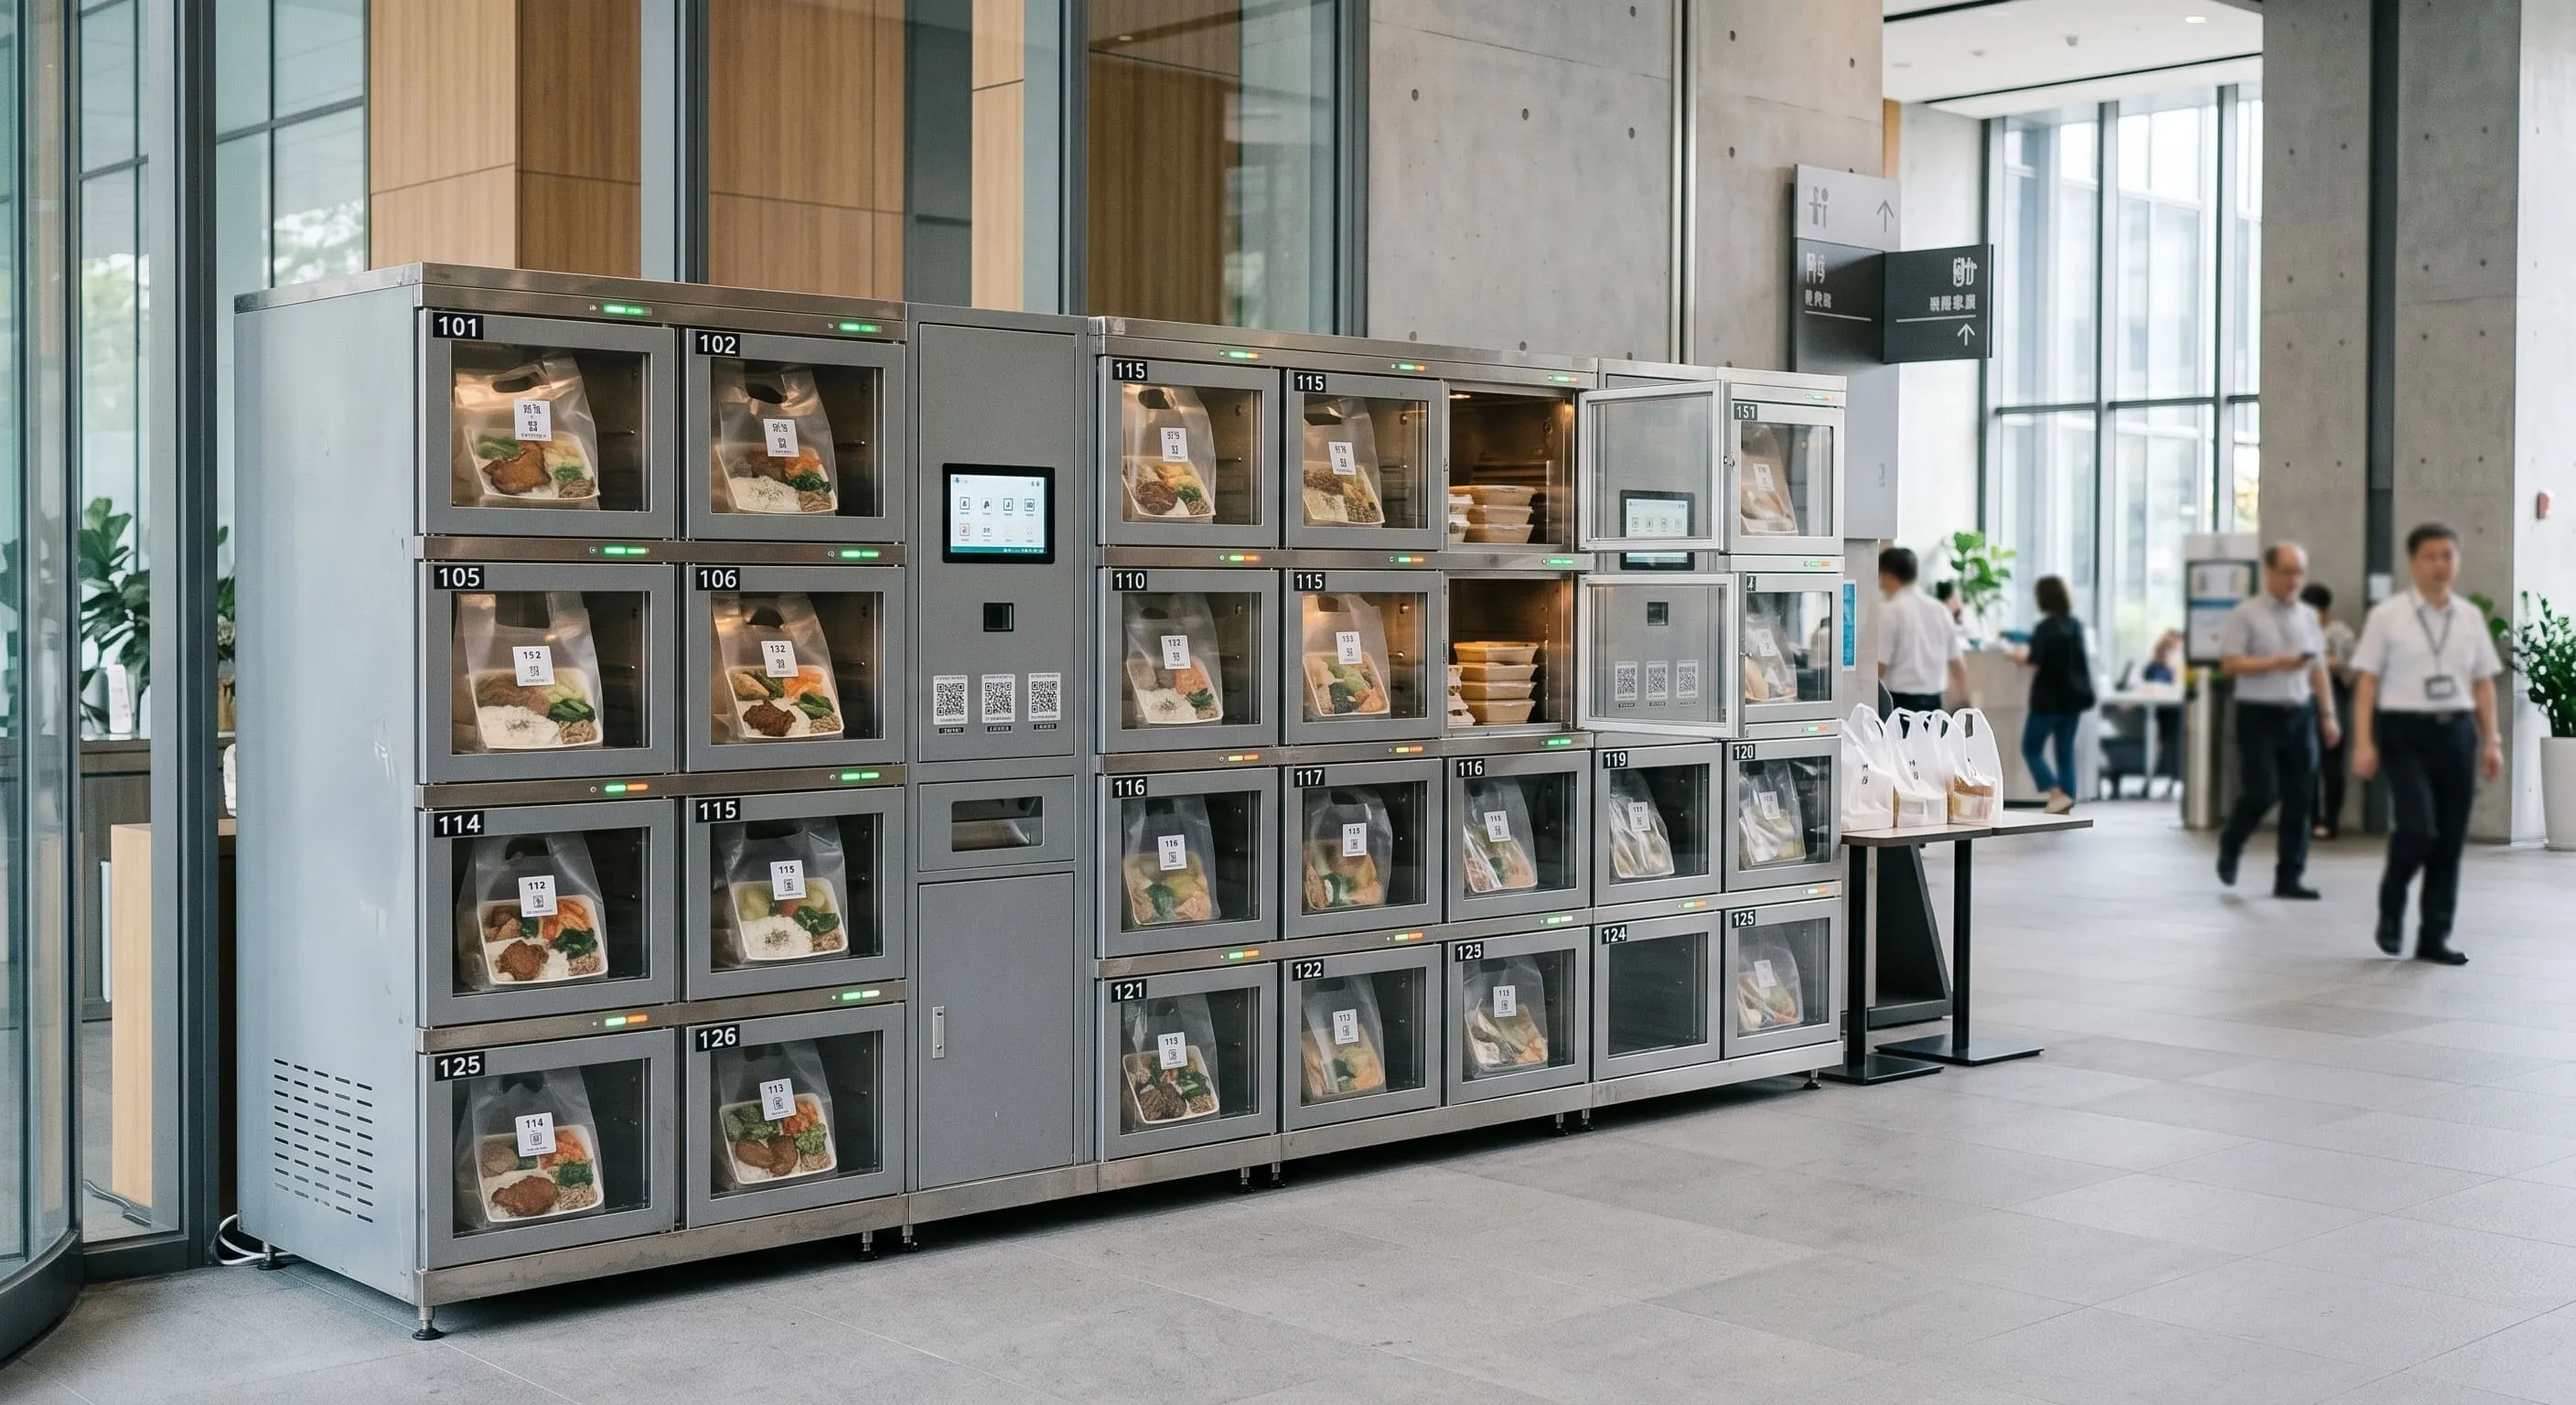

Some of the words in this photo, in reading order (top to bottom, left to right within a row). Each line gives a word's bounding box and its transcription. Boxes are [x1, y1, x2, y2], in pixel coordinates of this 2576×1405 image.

[439, 316, 477, 337] 101
[701, 335, 735, 354] 102
[1116, 362, 1144, 378] 115
[1297, 375, 1323, 391] 115
[439, 568, 479, 586] 105
[700, 570, 736, 588] 106
[1116, 574, 1144, 588] 110
[1297, 574, 1323, 589] 115
[770, 645, 786, 653] 132
[1605, 752, 1626, 767] 119
[1734, 745, 1754, 758] 120
[1459, 761, 1483, 776] 116
[1296, 770, 1323, 786] 117
[1116, 779, 1144, 796] 116
[701, 801, 735, 820] 115
[439, 814, 481, 834] 114
[529, 882, 545, 890] 112
[1734, 911, 1754, 926] 125
[1604, 928, 1626, 942] 124
[1295, 962, 1322, 979] 122
[1115, 982, 1143, 1000] 121
[701, 1027, 735, 1048] 126
[440, 1056, 480, 1077] 125
[768, 1084, 784, 1093] 113
[526, 1119, 543, 1128] 114
